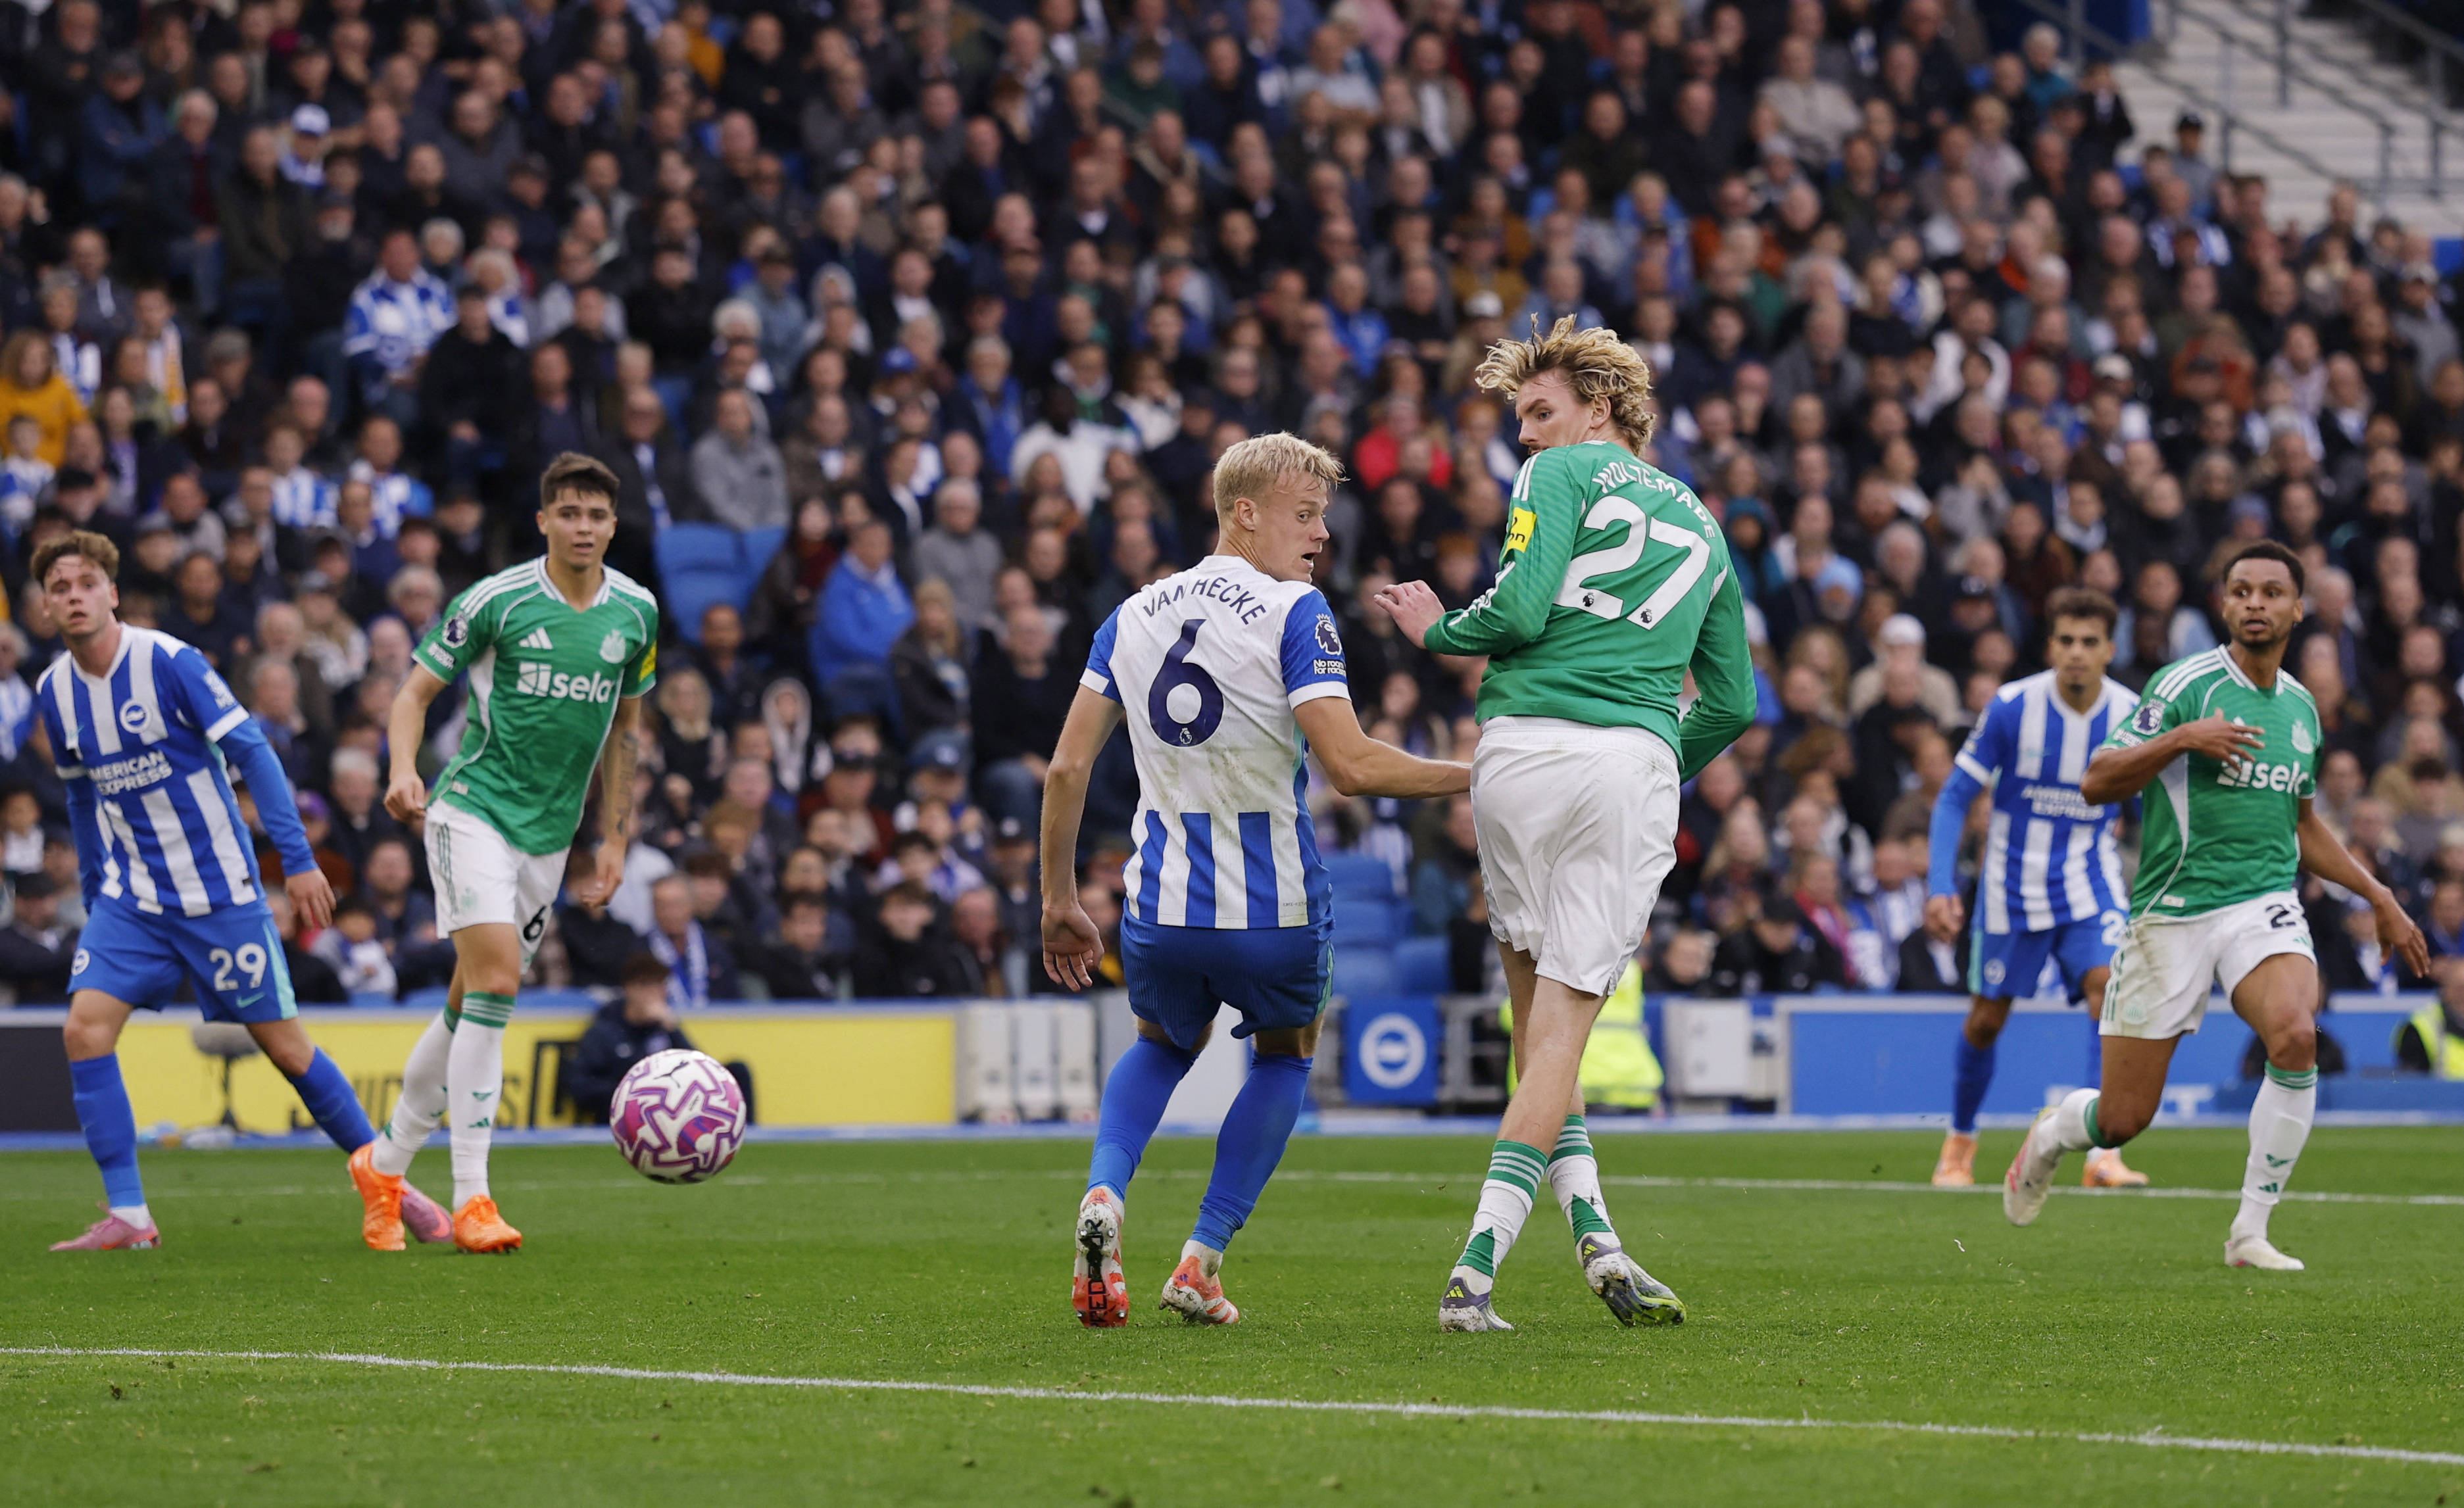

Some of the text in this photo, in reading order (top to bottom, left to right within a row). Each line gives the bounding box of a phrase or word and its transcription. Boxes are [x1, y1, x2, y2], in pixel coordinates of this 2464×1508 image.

[1592, 462, 1715, 538] WOLTEMADE
[1552, 495, 1710, 630] 27
[1143, 577, 1266, 625] VAN HECKE
[549, 670, 615, 703] sela
[1148, 619, 1224, 747] 6
[1314, 659, 1326, 668] No
[209, 942, 267, 992] 29
